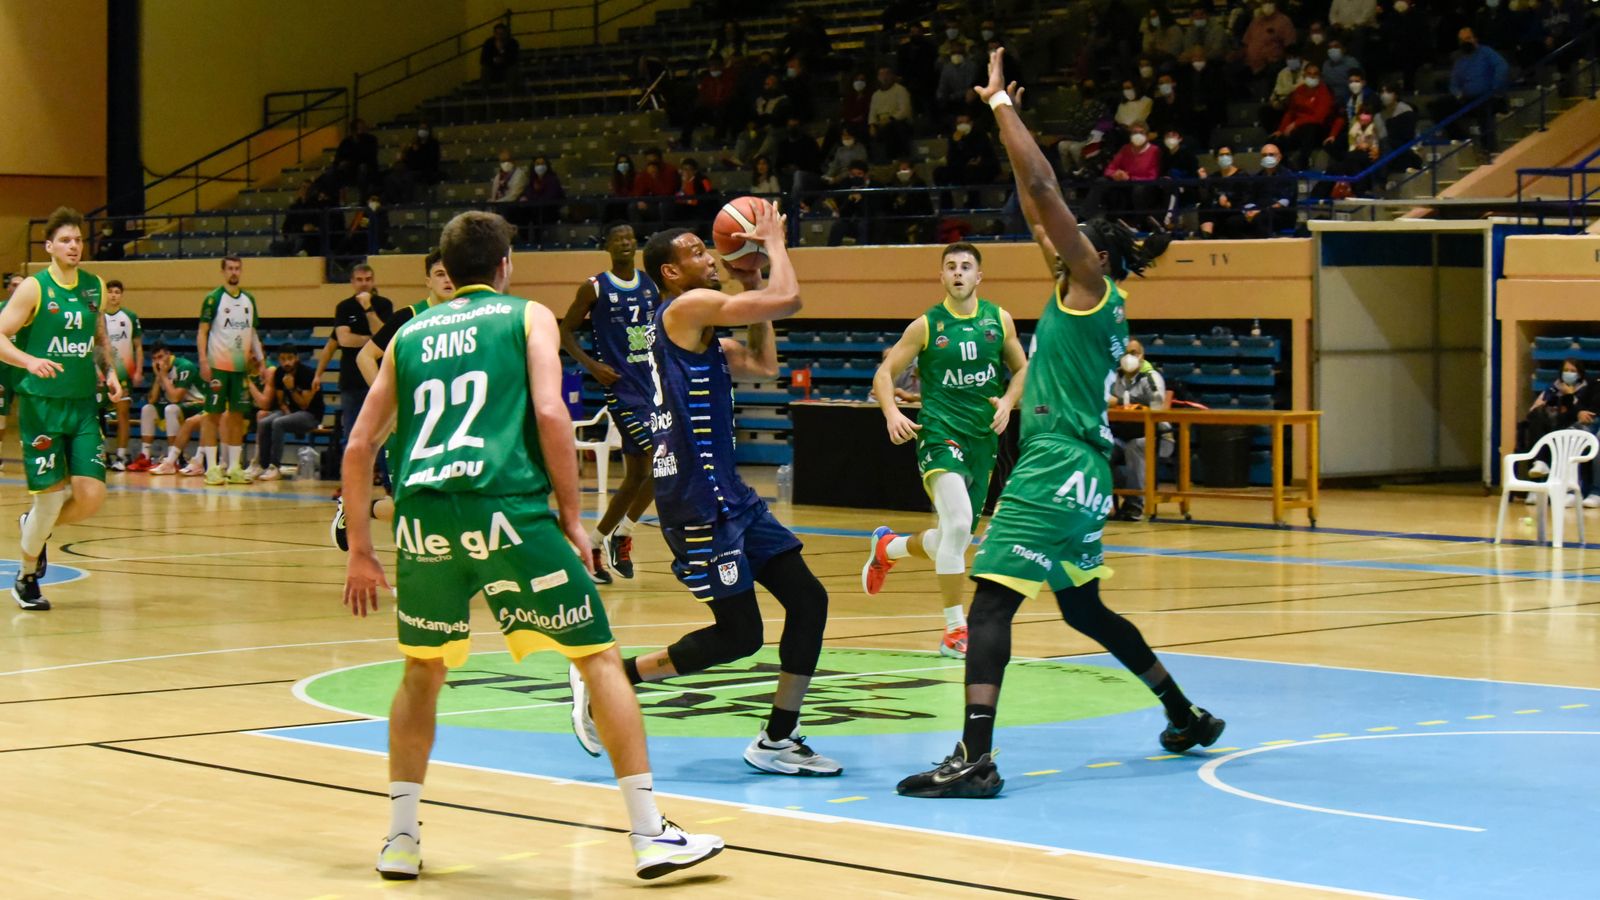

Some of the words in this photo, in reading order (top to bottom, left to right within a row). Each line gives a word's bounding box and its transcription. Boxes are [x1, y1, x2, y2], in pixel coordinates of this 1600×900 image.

[64, 311, 83, 330] 24
[628, 305, 640, 323] 7
[421, 326, 478, 364] SANS
[959, 341, 978, 362] 10
[942, 362, 996, 387] AlegA
[410, 370, 489, 462] 22
[35, 453, 56, 476] 24
[499, 594, 594, 633] Sociedad
